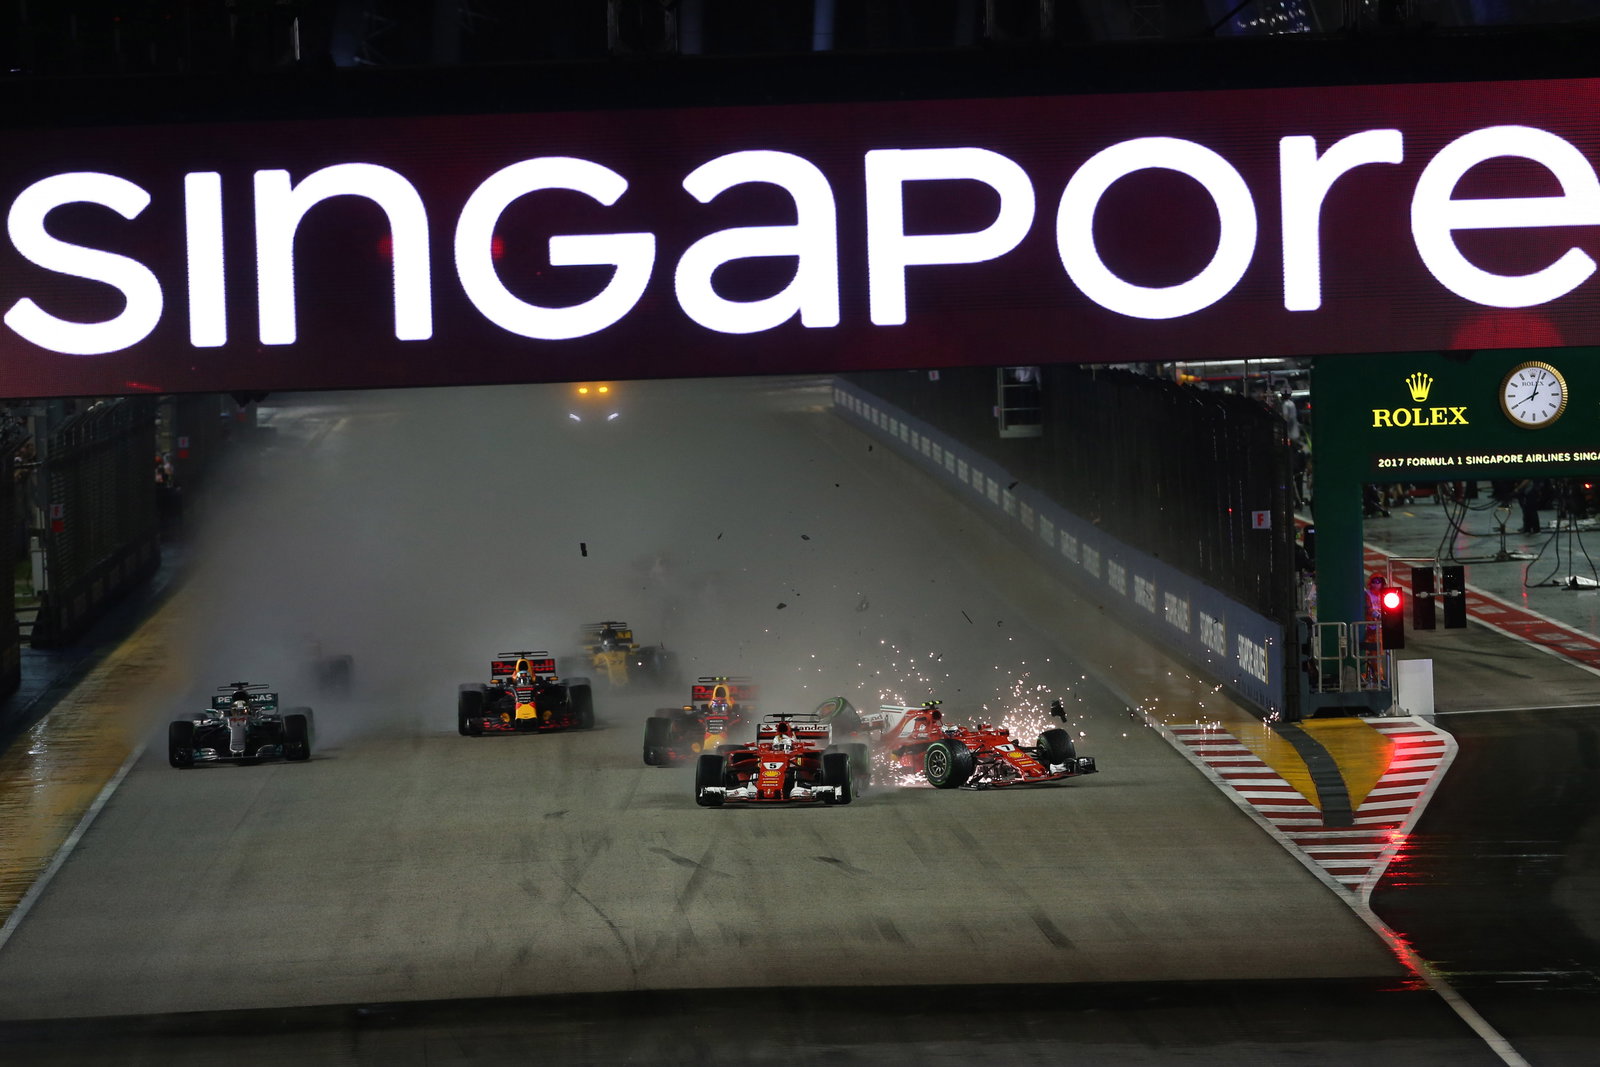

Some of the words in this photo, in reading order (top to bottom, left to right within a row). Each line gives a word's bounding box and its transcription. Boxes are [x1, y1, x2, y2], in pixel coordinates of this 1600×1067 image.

[1372, 406, 1469, 427] ROLEX
[1378, 458, 1404, 468] 2017
[1407, 456, 1454, 467] FORMULA
[1457, 456, 1463, 466] 1
[1465, 454, 1524, 465] SINGAPORE
[1525, 452, 1571, 463] AIRLINES
[1257, 512, 1265, 527] F
